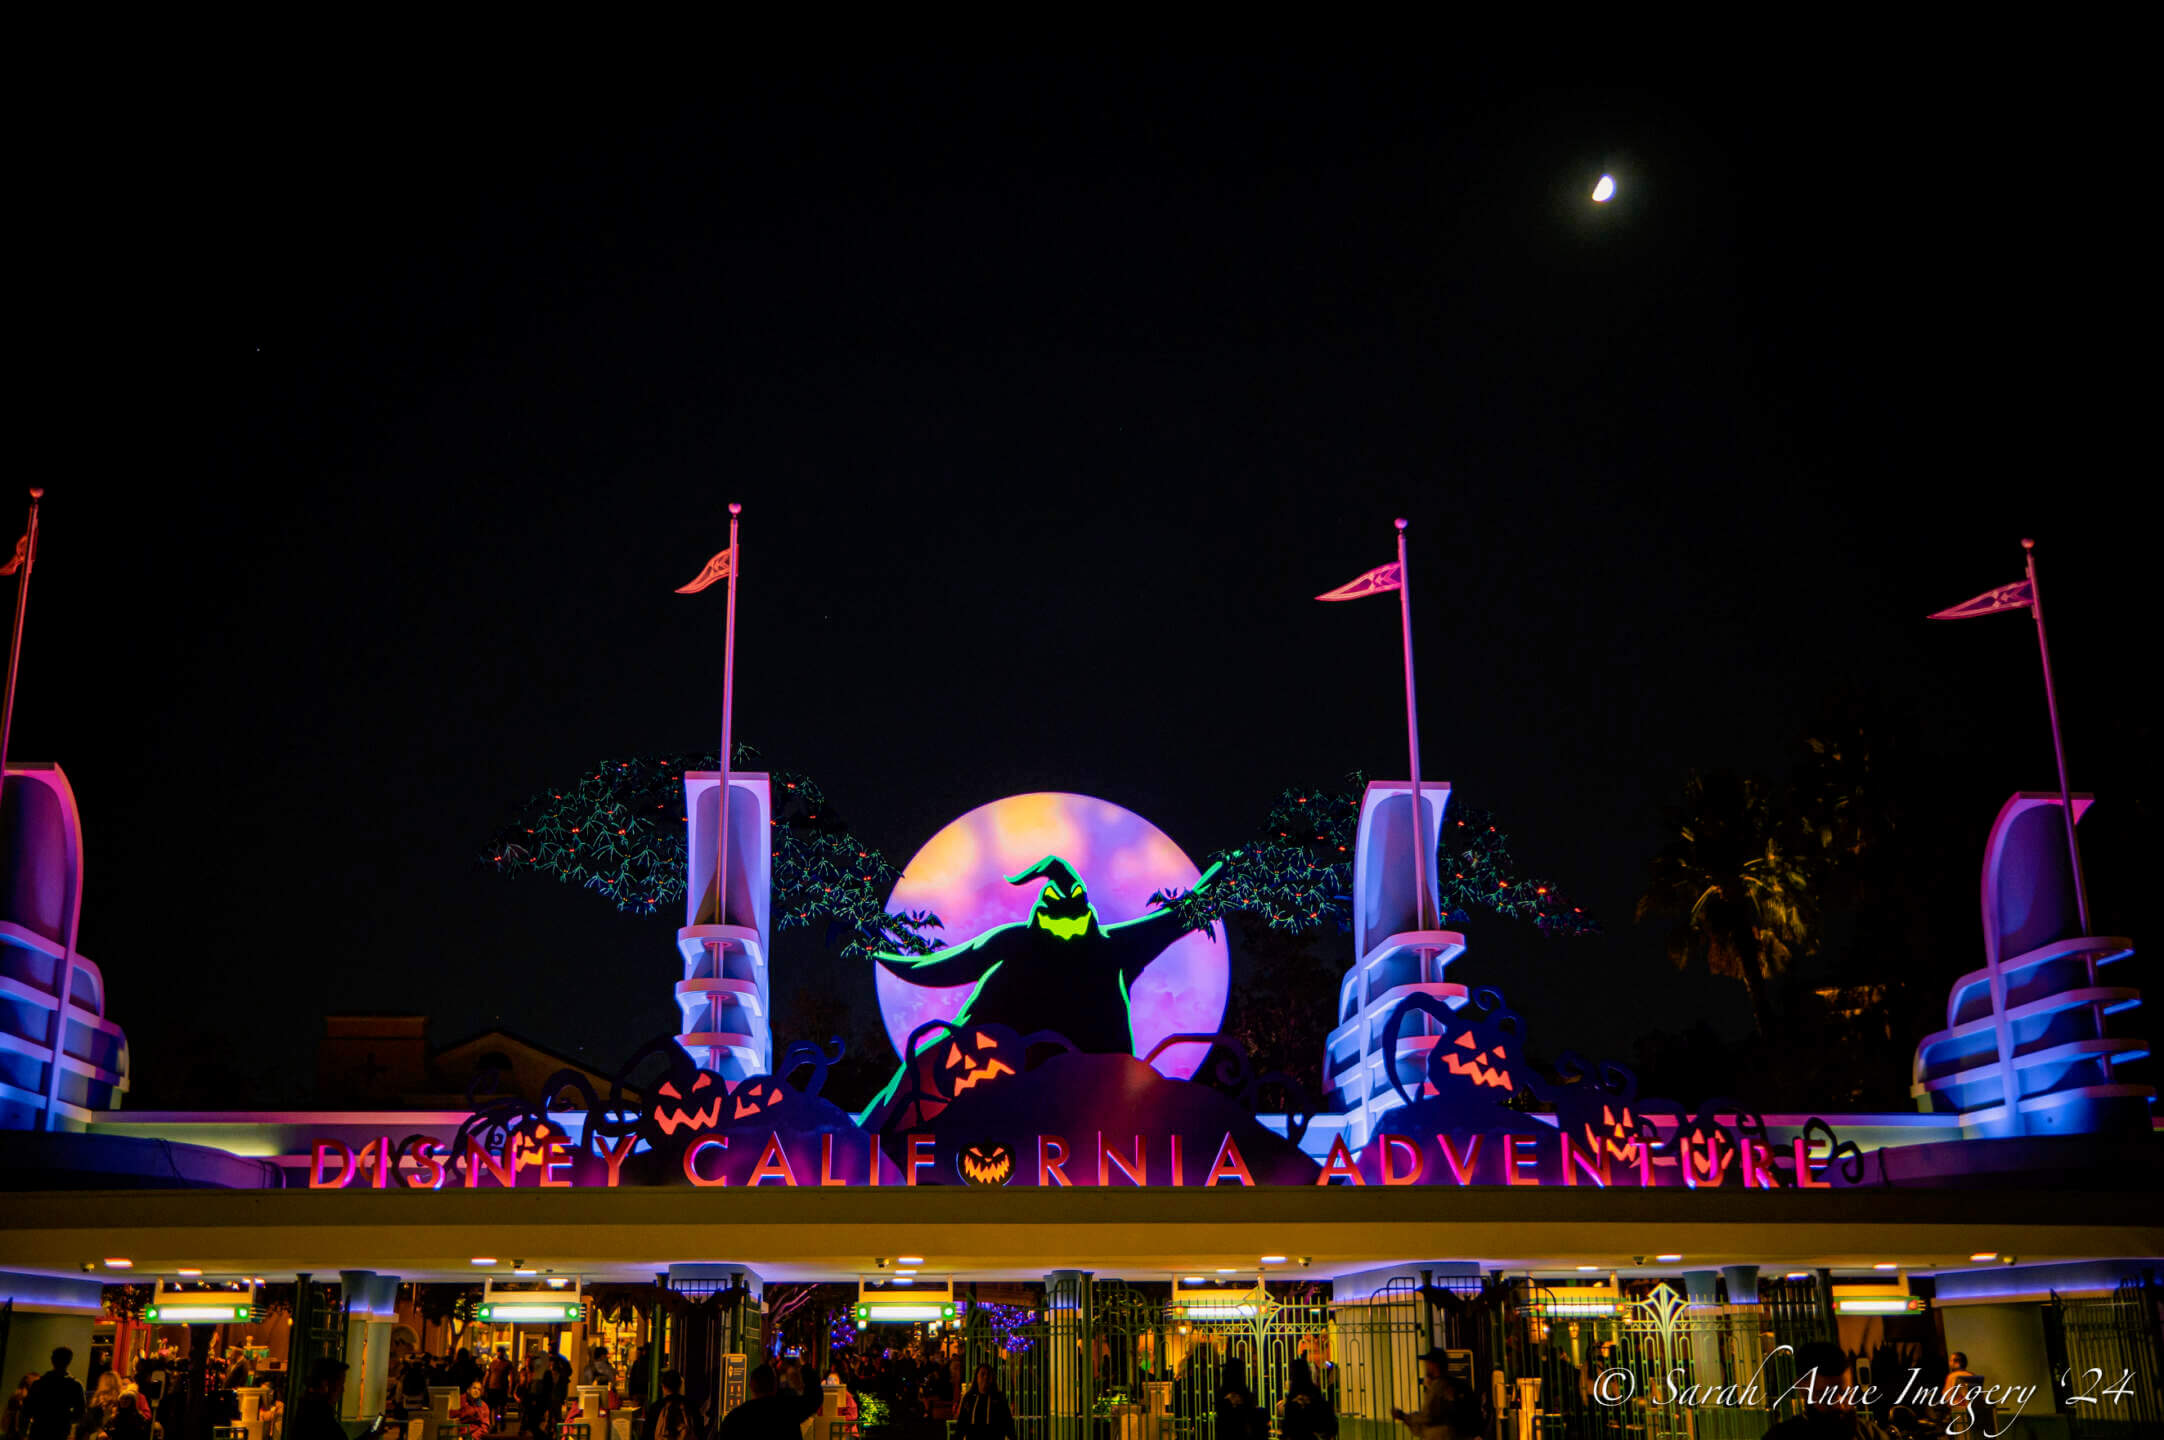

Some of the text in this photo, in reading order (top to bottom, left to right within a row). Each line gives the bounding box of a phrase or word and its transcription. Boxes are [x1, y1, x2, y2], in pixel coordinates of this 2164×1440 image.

[308, 1131, 1832, 1190] DISNEY CALIFRNIA ADVENTURE
